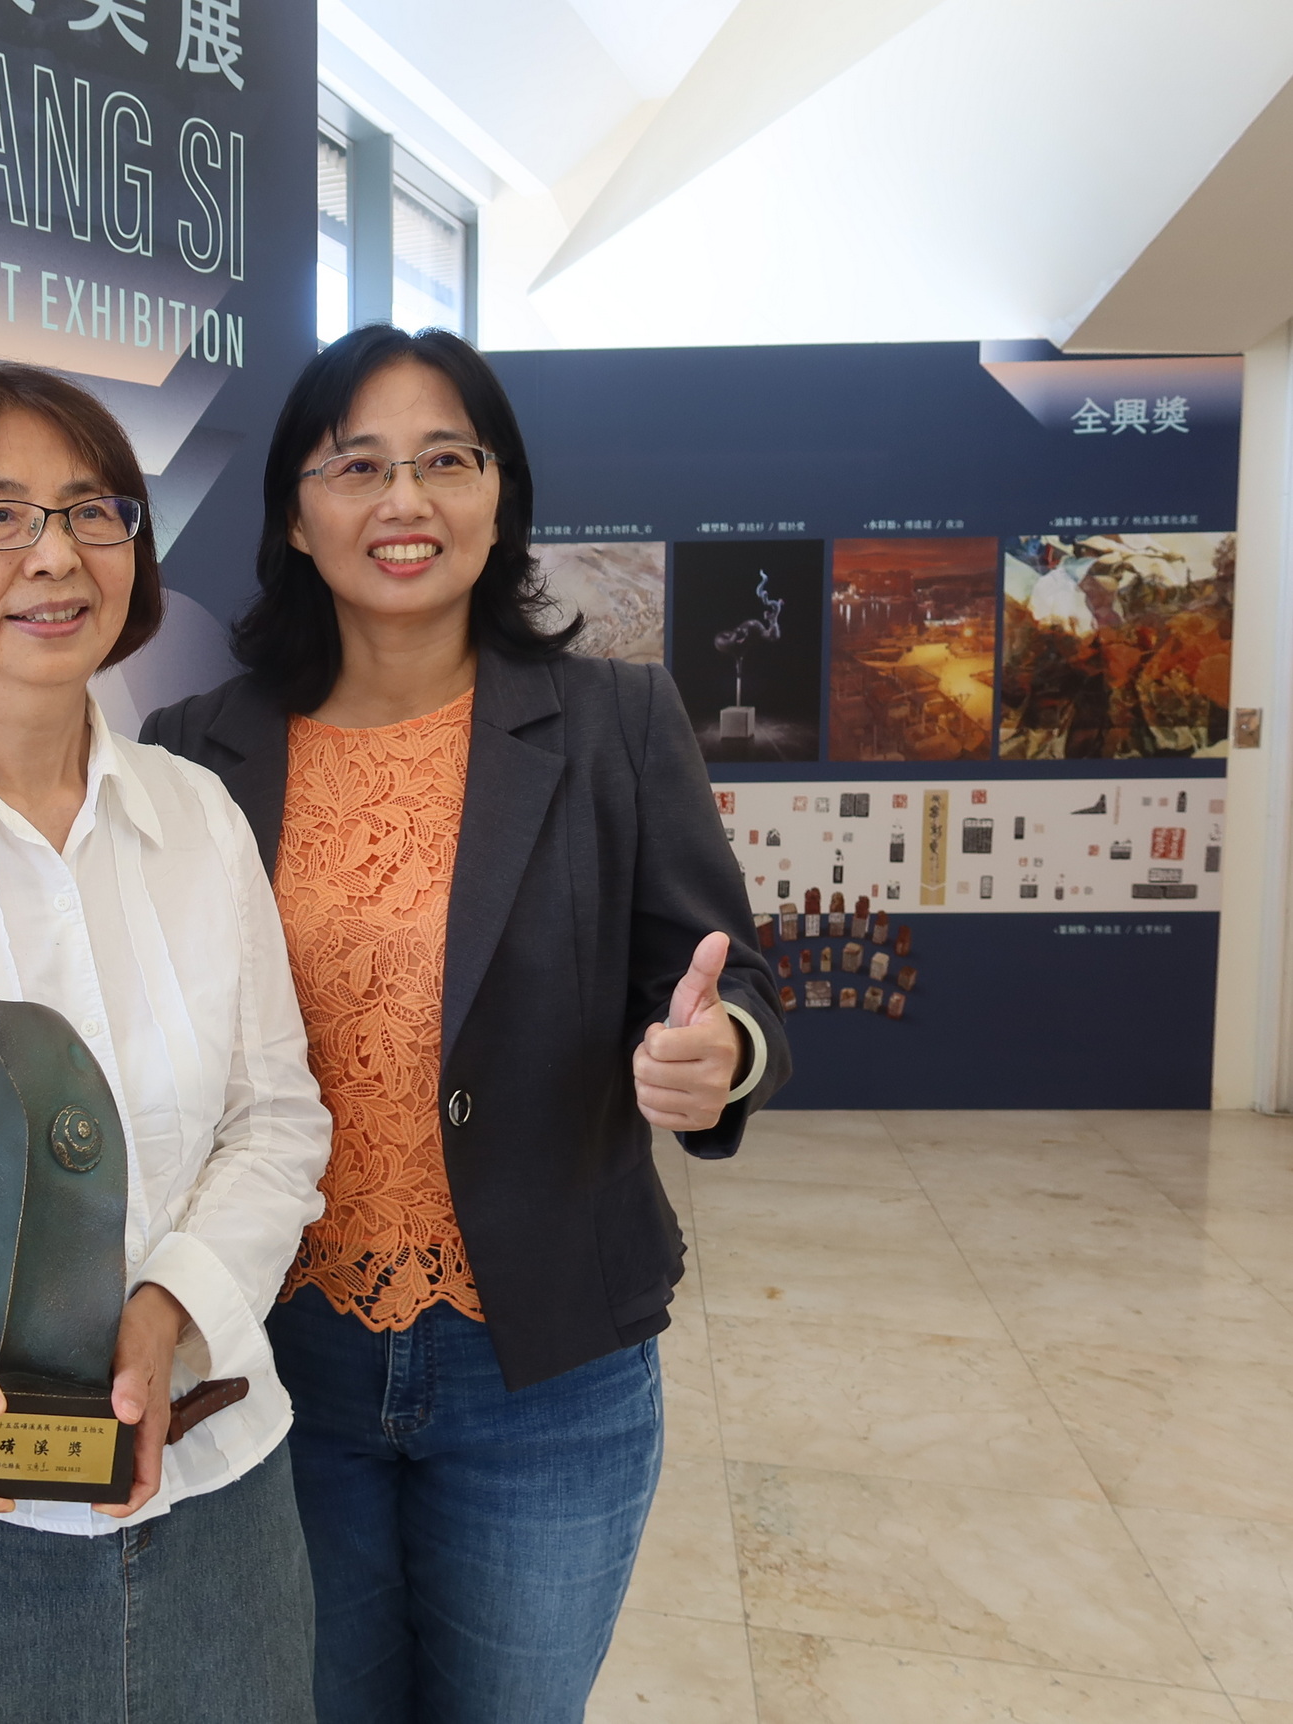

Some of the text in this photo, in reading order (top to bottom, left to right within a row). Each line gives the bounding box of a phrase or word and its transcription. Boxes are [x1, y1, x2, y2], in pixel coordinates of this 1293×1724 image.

[178, 117, 245, 282] SI
[41, 271, 245, 368] EXHIBITION
[1070, 395, 1191, 436] 全興獎
